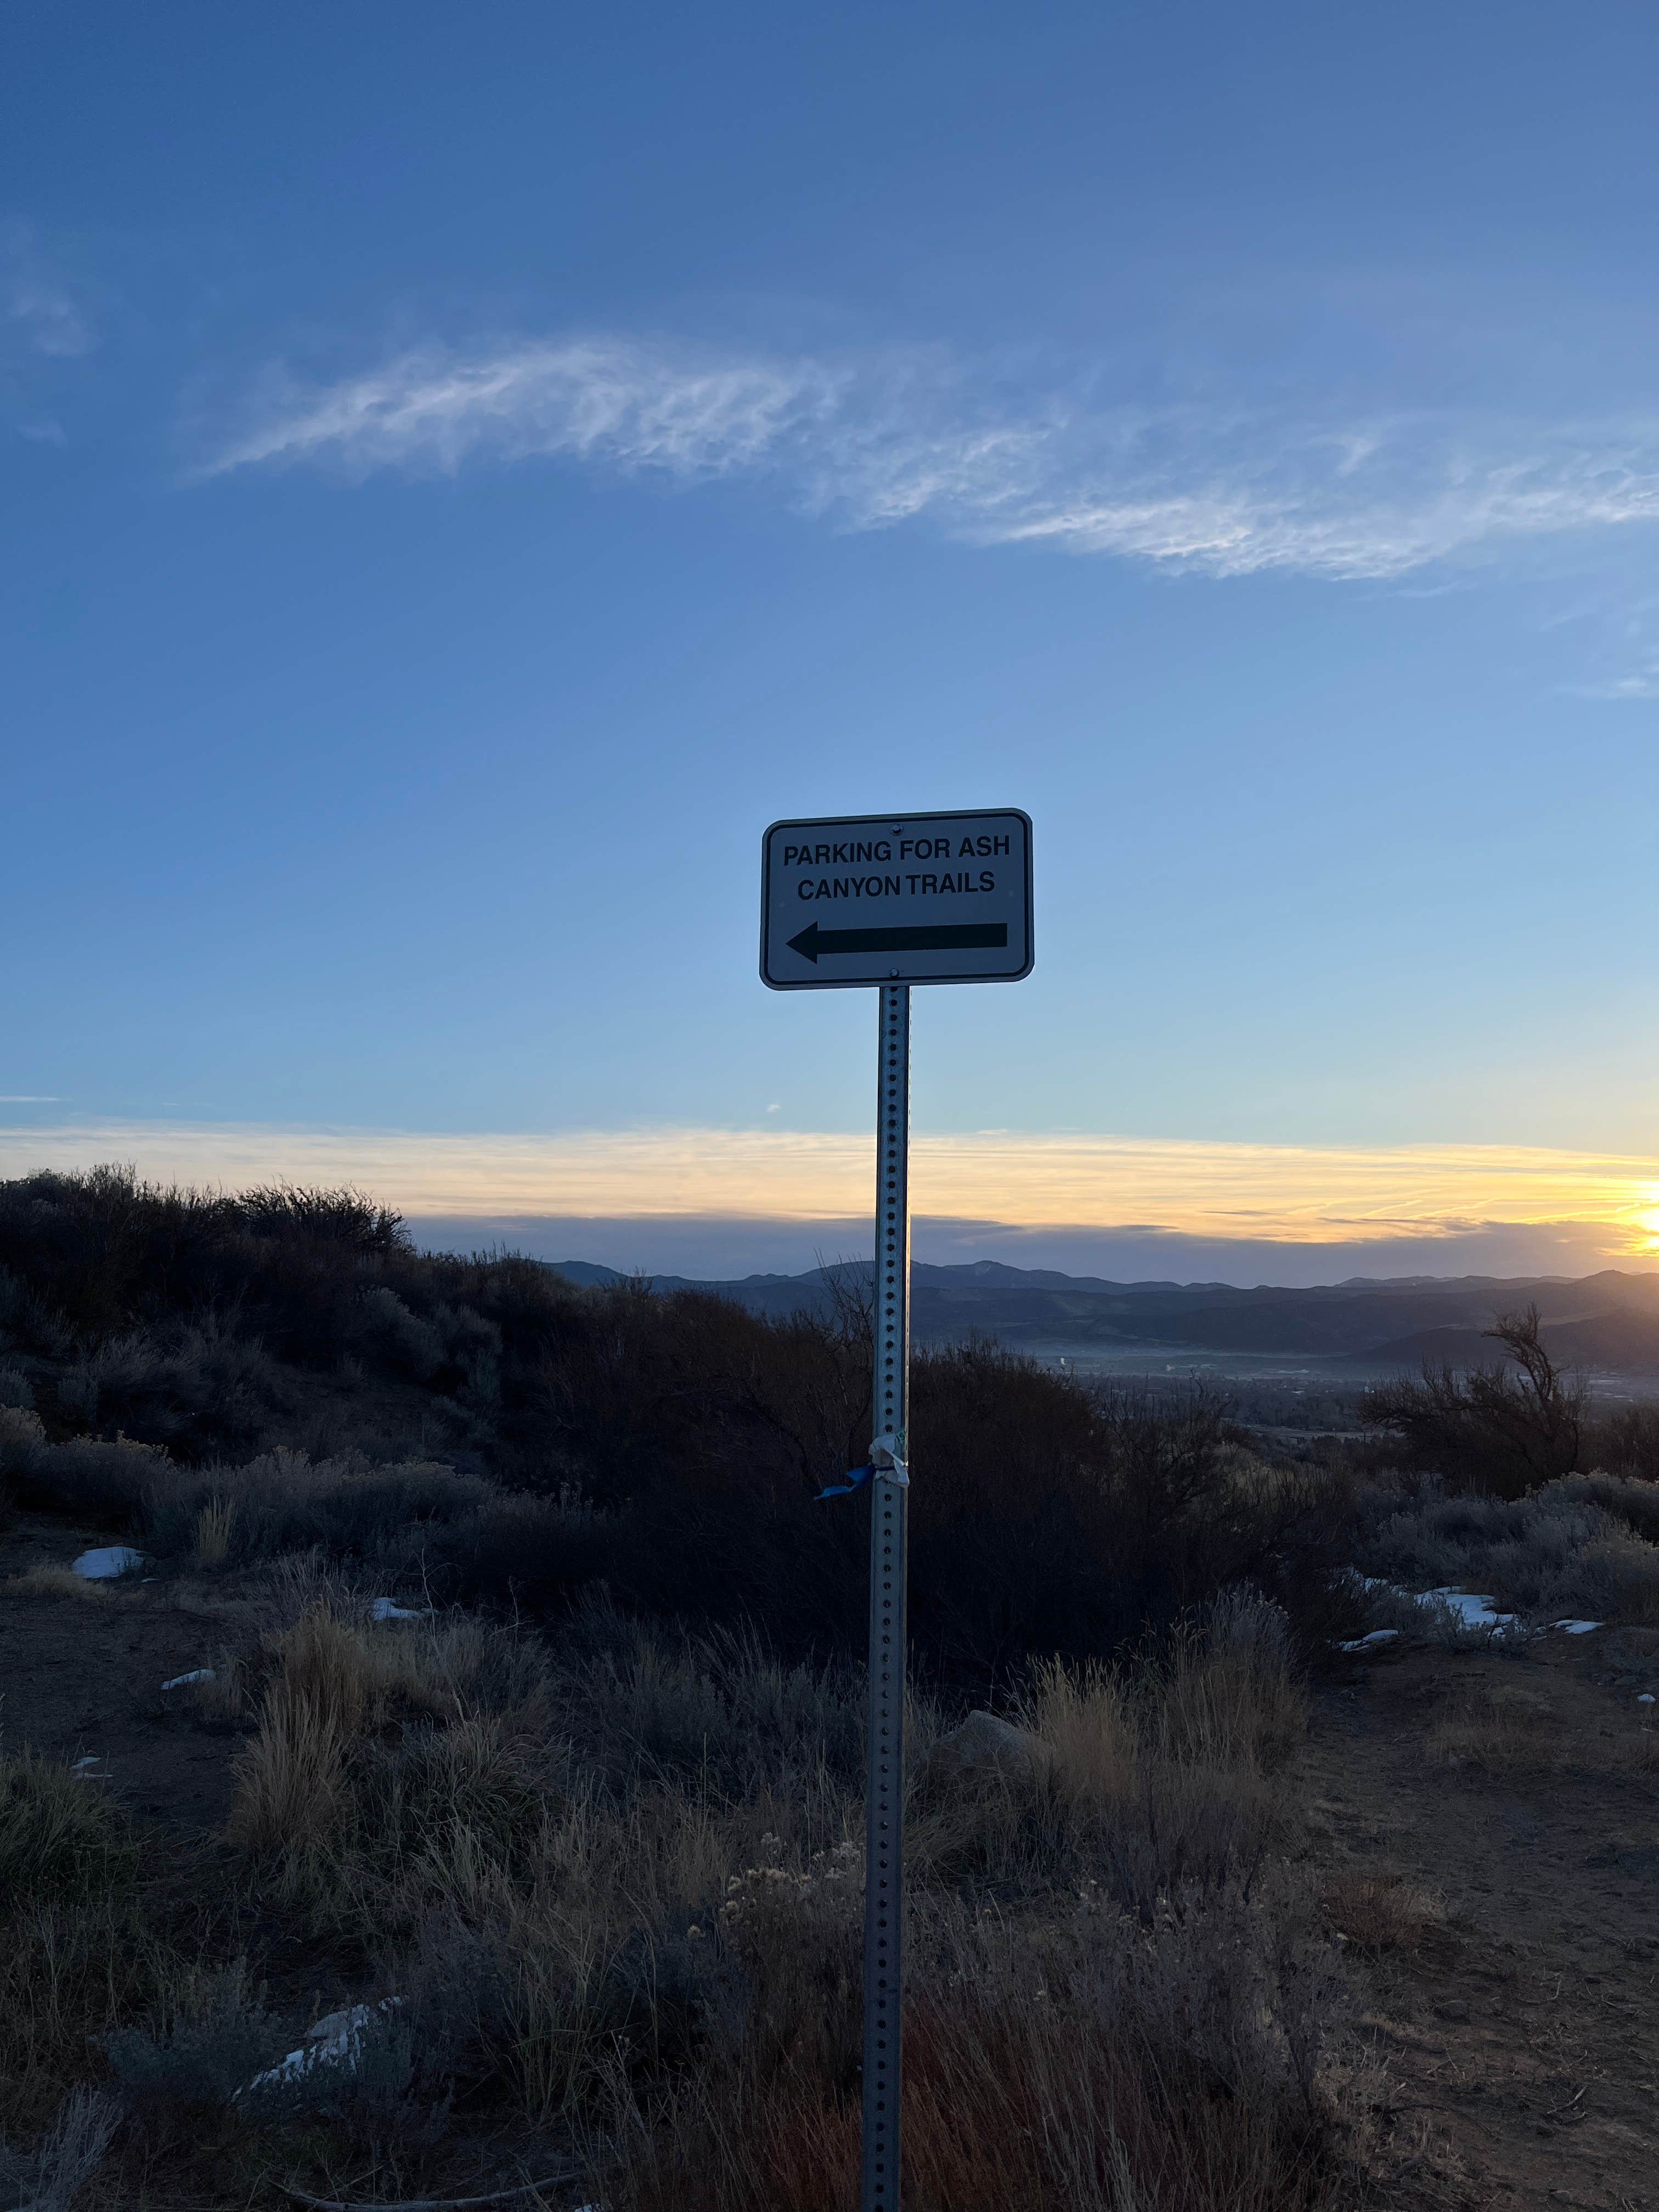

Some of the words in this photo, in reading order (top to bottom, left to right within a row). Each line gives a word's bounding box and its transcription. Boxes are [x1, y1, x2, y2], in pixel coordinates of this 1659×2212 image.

[784, 841, 891, 866] PARKING
[900, 838, 950, 860] FOR
[958, 835, 1009, 857] ASH
[798, 876, 900, 900] CANYON
[906, 871, 995, 895] TRAILS
